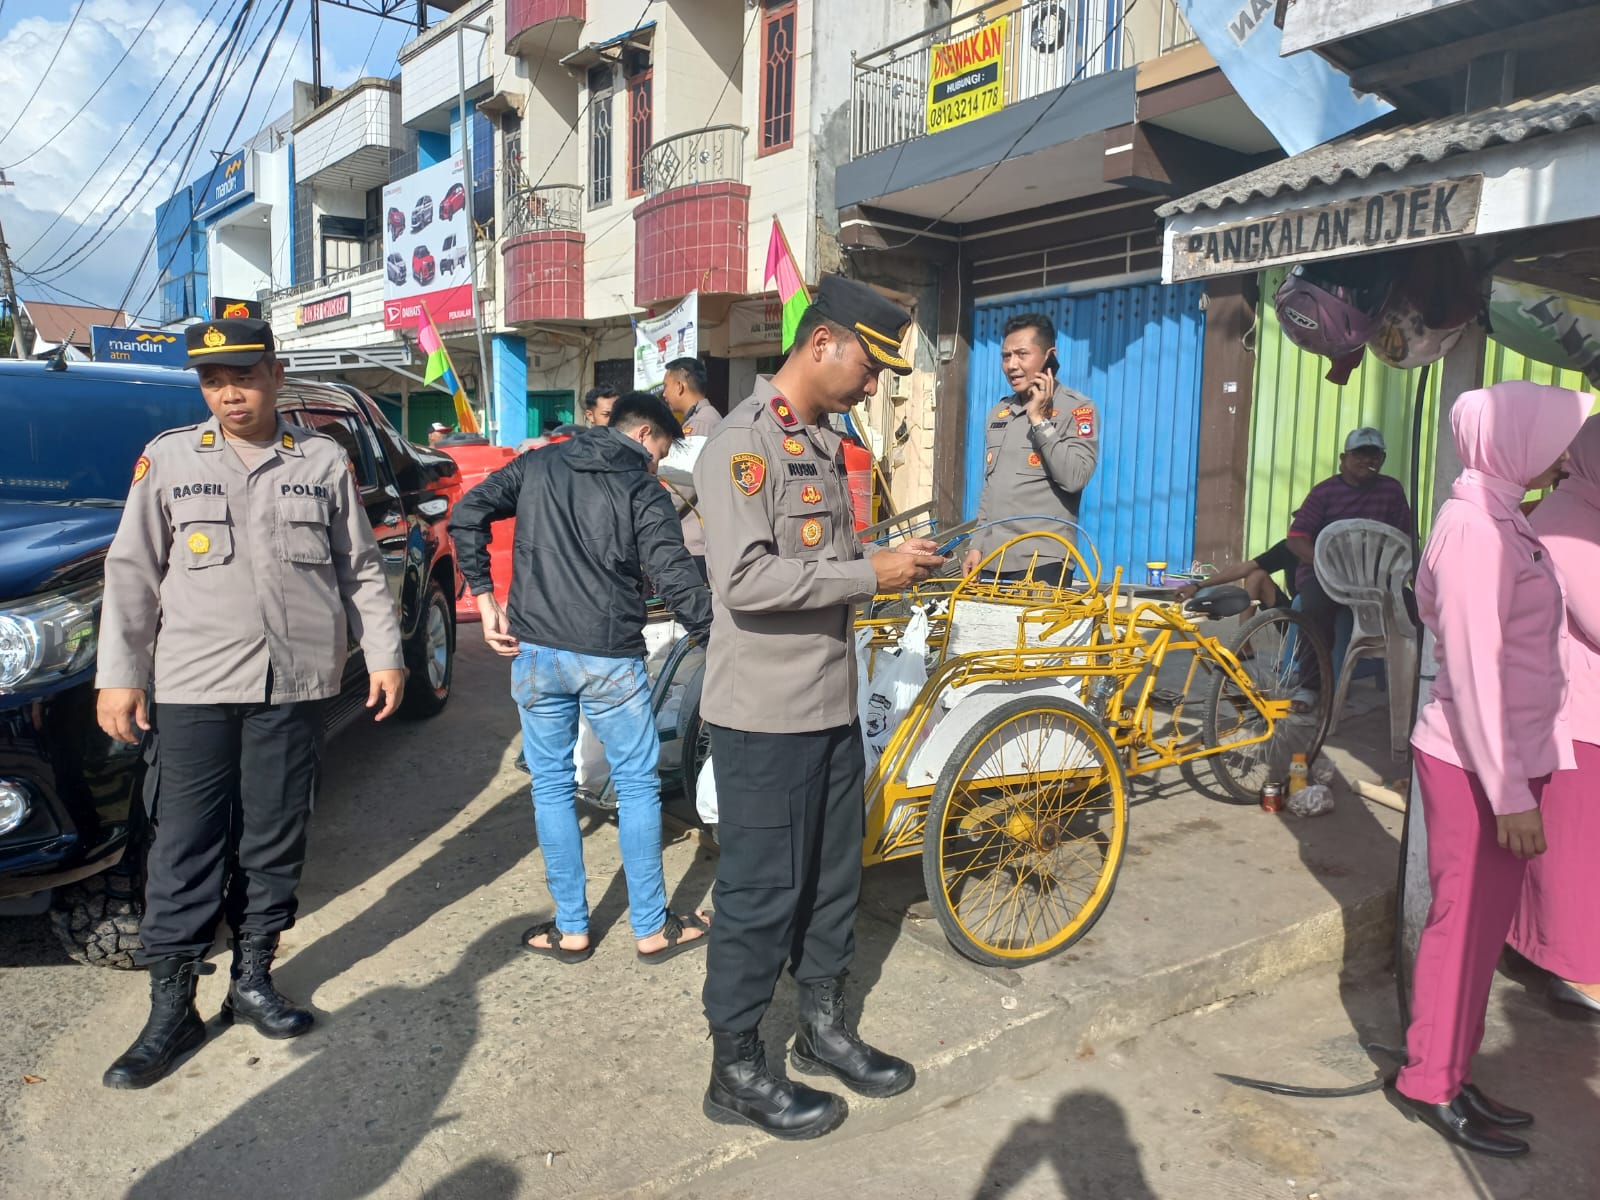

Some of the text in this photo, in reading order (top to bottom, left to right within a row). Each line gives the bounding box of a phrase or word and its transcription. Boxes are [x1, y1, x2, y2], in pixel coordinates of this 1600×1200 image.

[934, 26, 1001, 79] DISEWAKAN
[946, 74, 981, 93] HUBUNGI
[930, 86, 999, 128] 0812 3214 778
[1364, 184, 1459, 247] OJEK
[402, 305, 422, 318] DAIHATS
[109, 340, 163, 353] mandiri
[110, 352, 130, 360] atm
[788, 463, 818, 476] RUSDI
[173, 483, 225, 499] RAGEIL
[281, 484, 329, 498] POLRI
